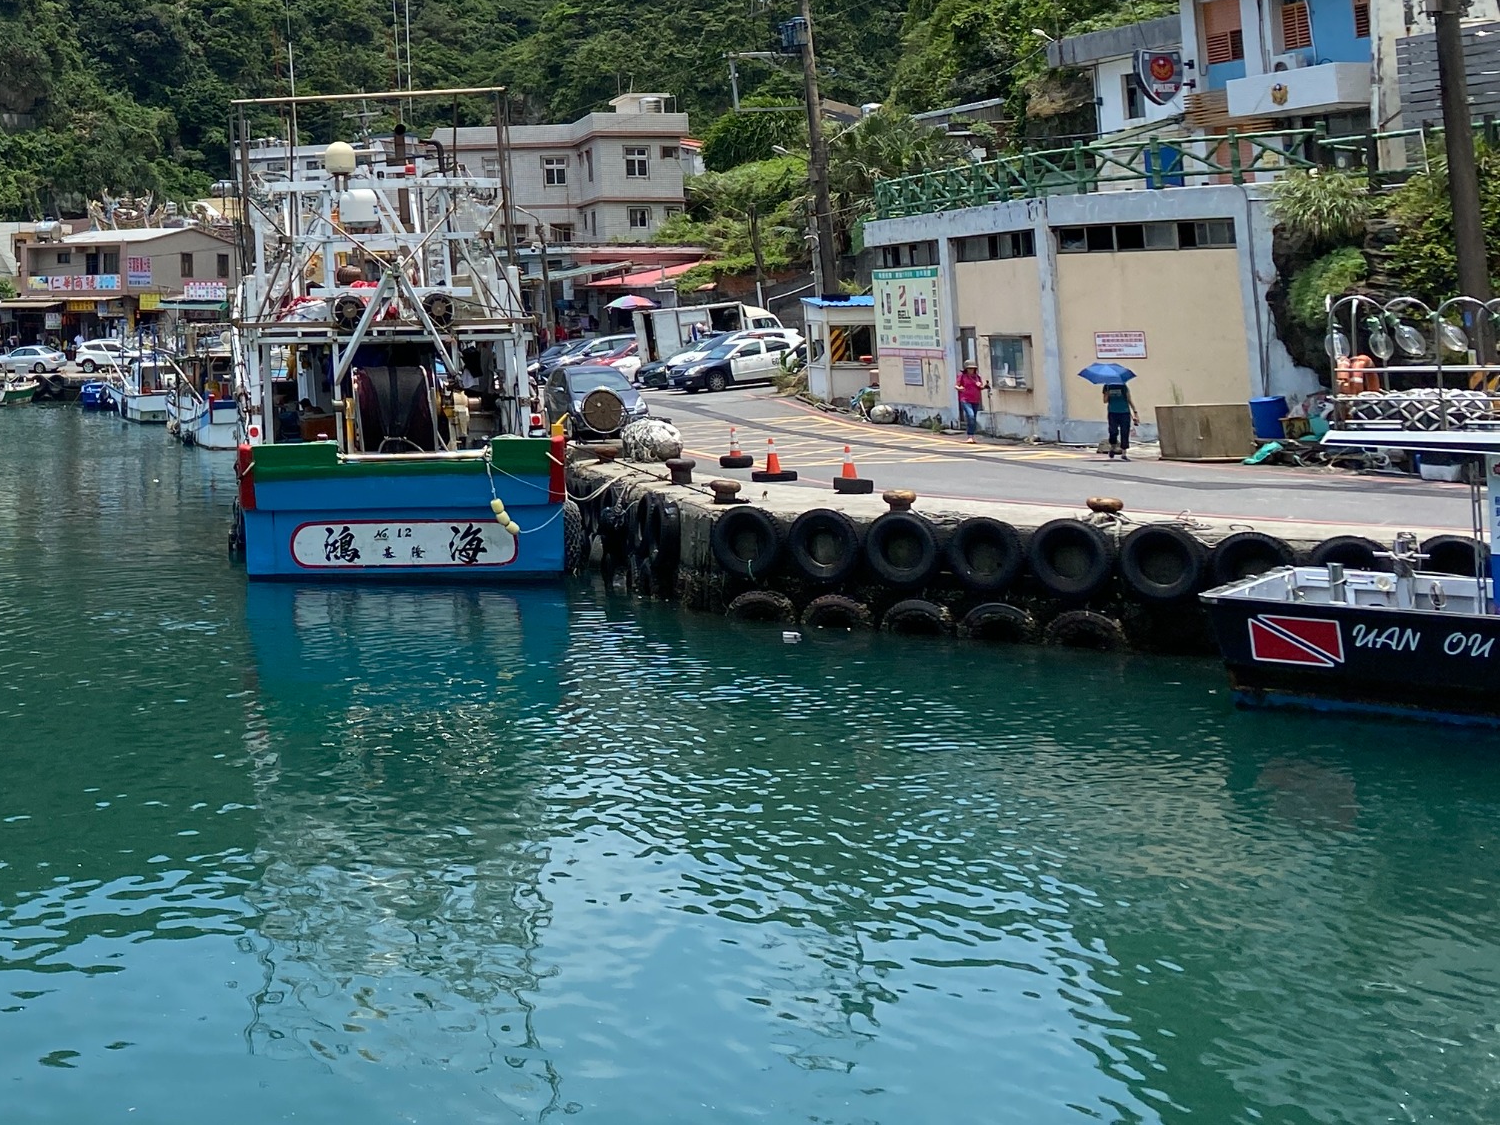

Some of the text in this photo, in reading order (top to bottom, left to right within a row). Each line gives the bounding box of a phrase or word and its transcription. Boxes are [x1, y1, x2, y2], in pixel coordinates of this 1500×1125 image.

[324, 526, 361, 563] 鴻
[397, 528, 412, 538] 12
[449, 523, 488, 564] 海
